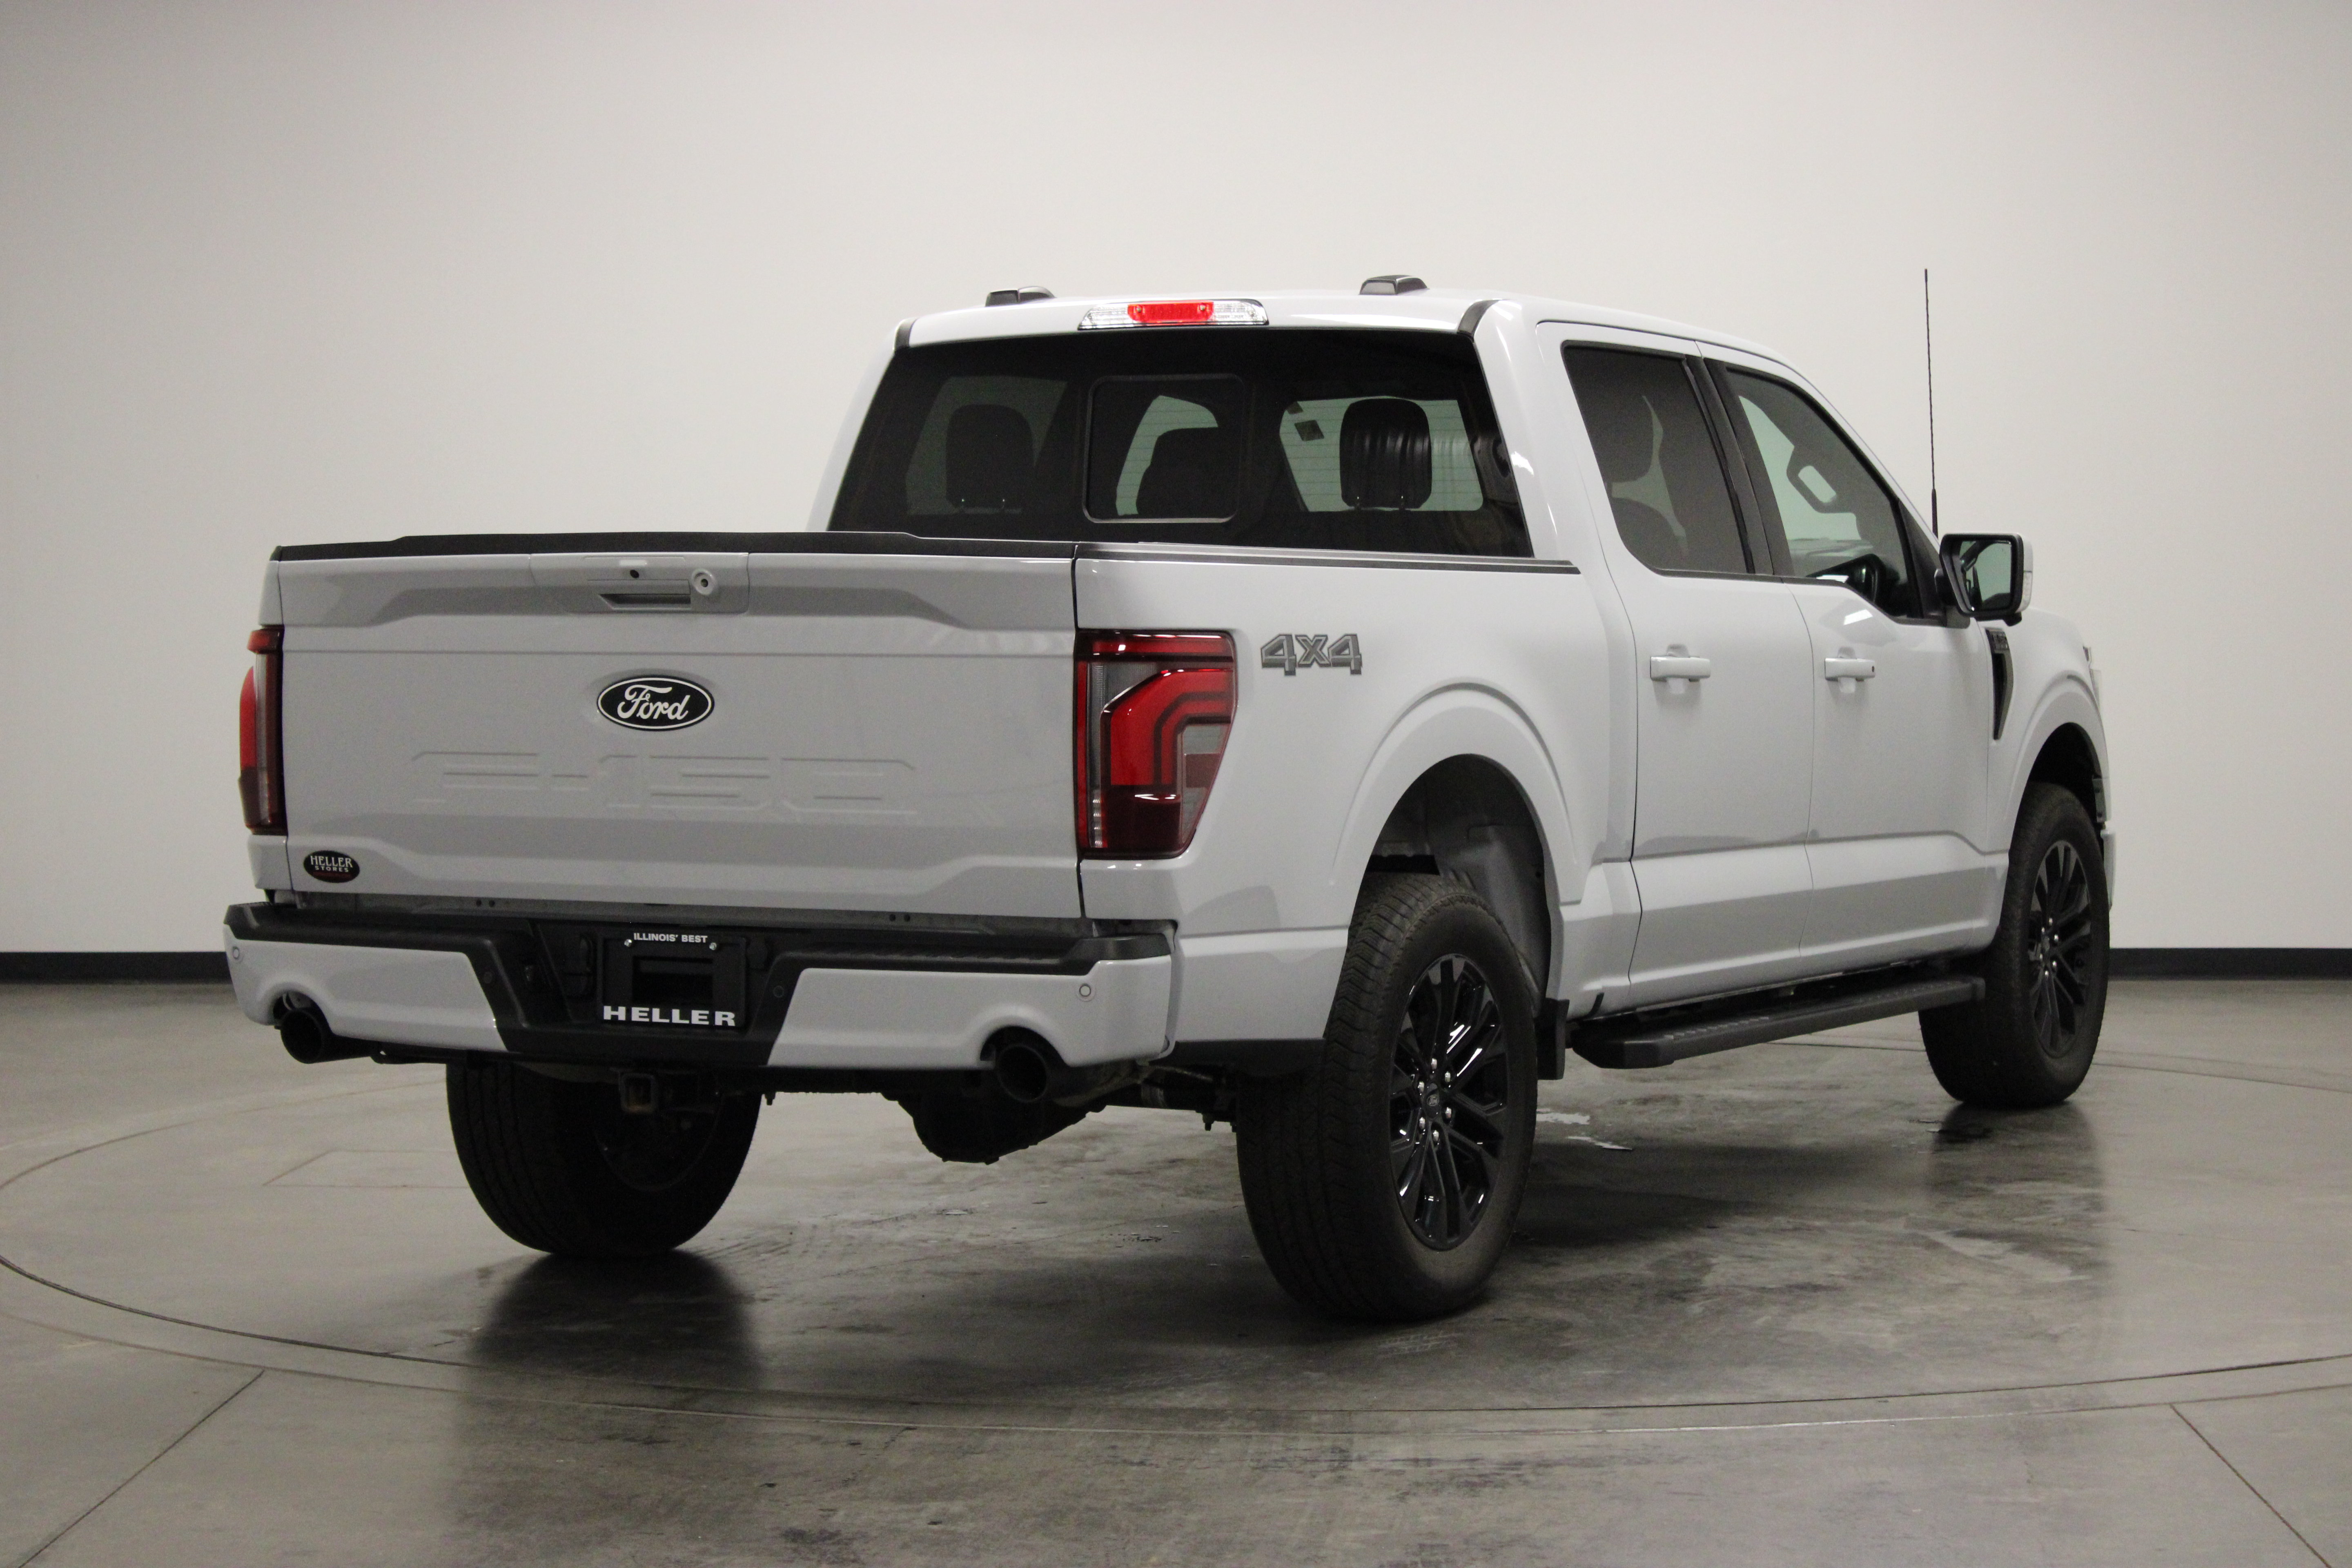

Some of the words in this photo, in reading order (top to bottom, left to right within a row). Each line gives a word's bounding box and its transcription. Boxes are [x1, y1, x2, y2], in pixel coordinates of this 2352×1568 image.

[617, 684, 690, 720] Ford
[310, 855, 353, 868] HELLER
[681, 934, 708, 943] BEST
[603, 1005, 735, 1027] HELLER
